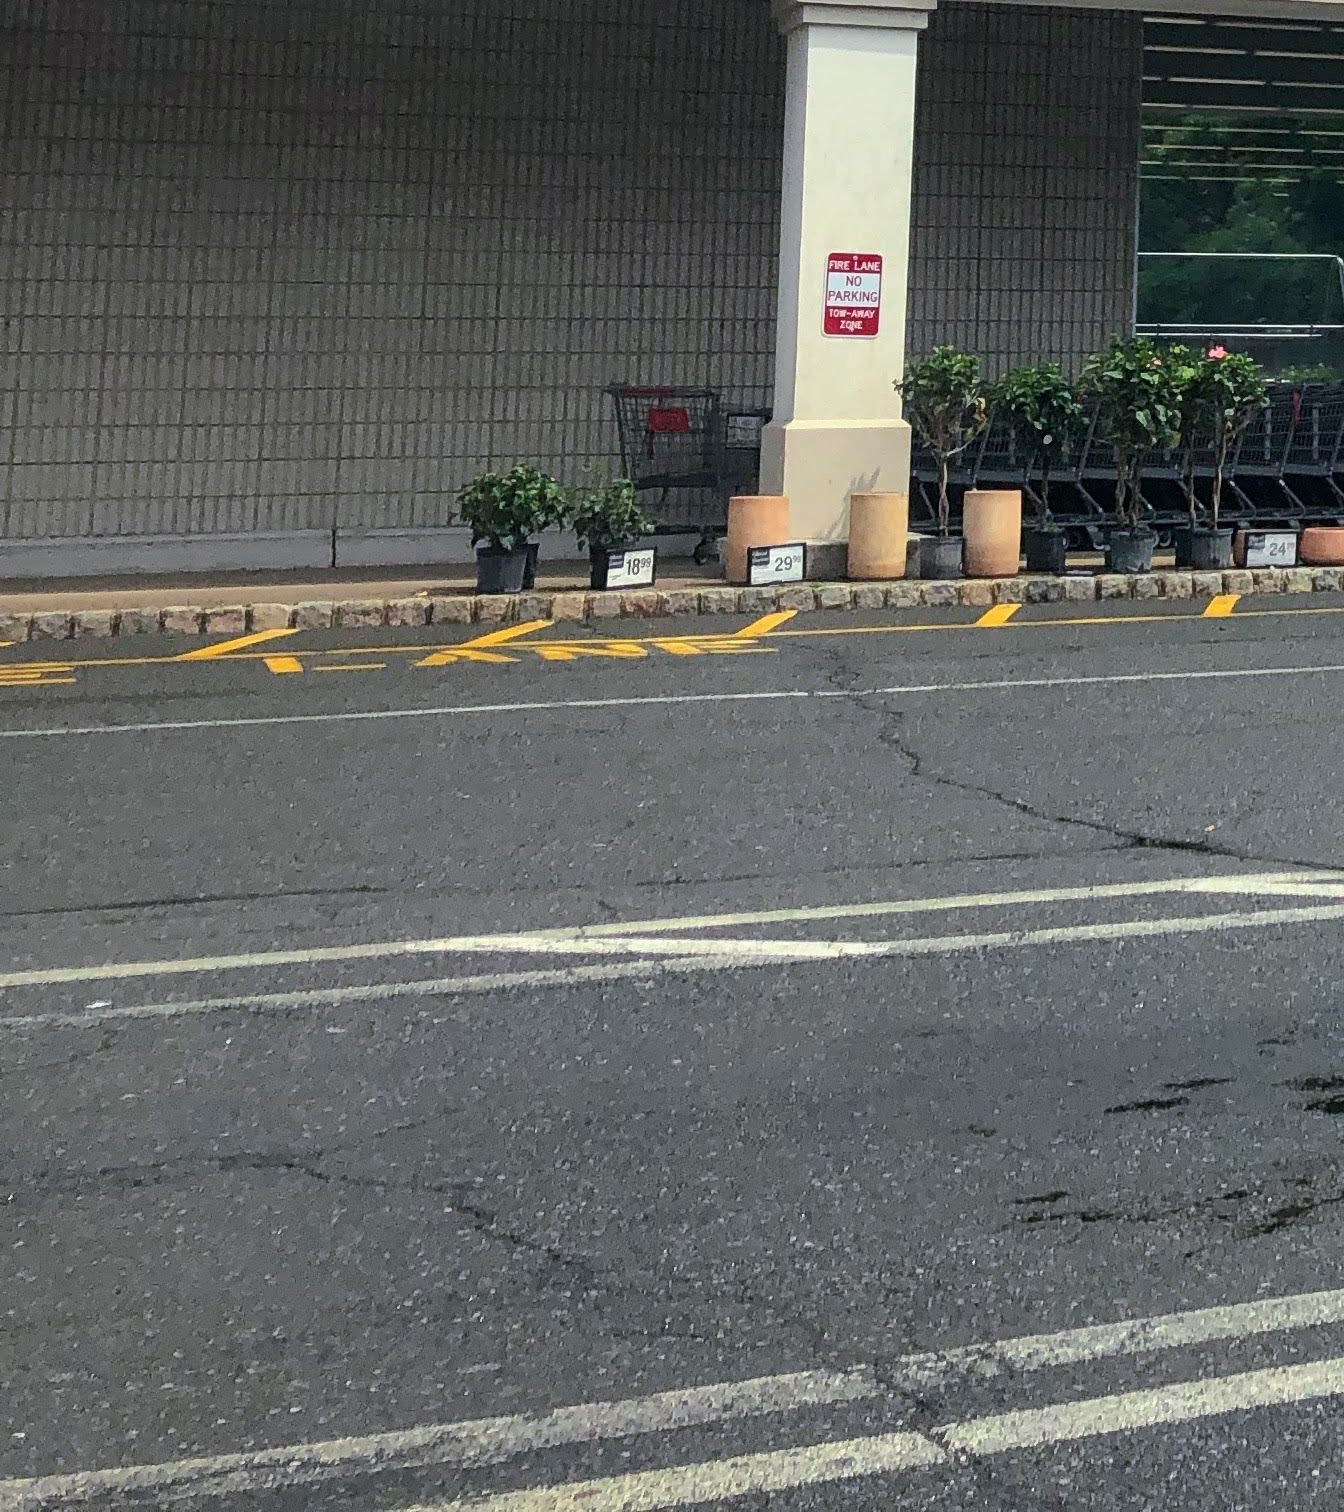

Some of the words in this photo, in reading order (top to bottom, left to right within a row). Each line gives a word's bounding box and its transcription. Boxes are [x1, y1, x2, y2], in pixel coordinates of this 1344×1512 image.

[828, 260, 851, 271] FIRE
[854, 260, 881, 272] LANE
[845, 275, 862, 287] NO
[828, 290, 878, 303] PARKING
[829, 308, 876, 319] TOW-AWAY
[840, 320, 863, 330] ZONE
